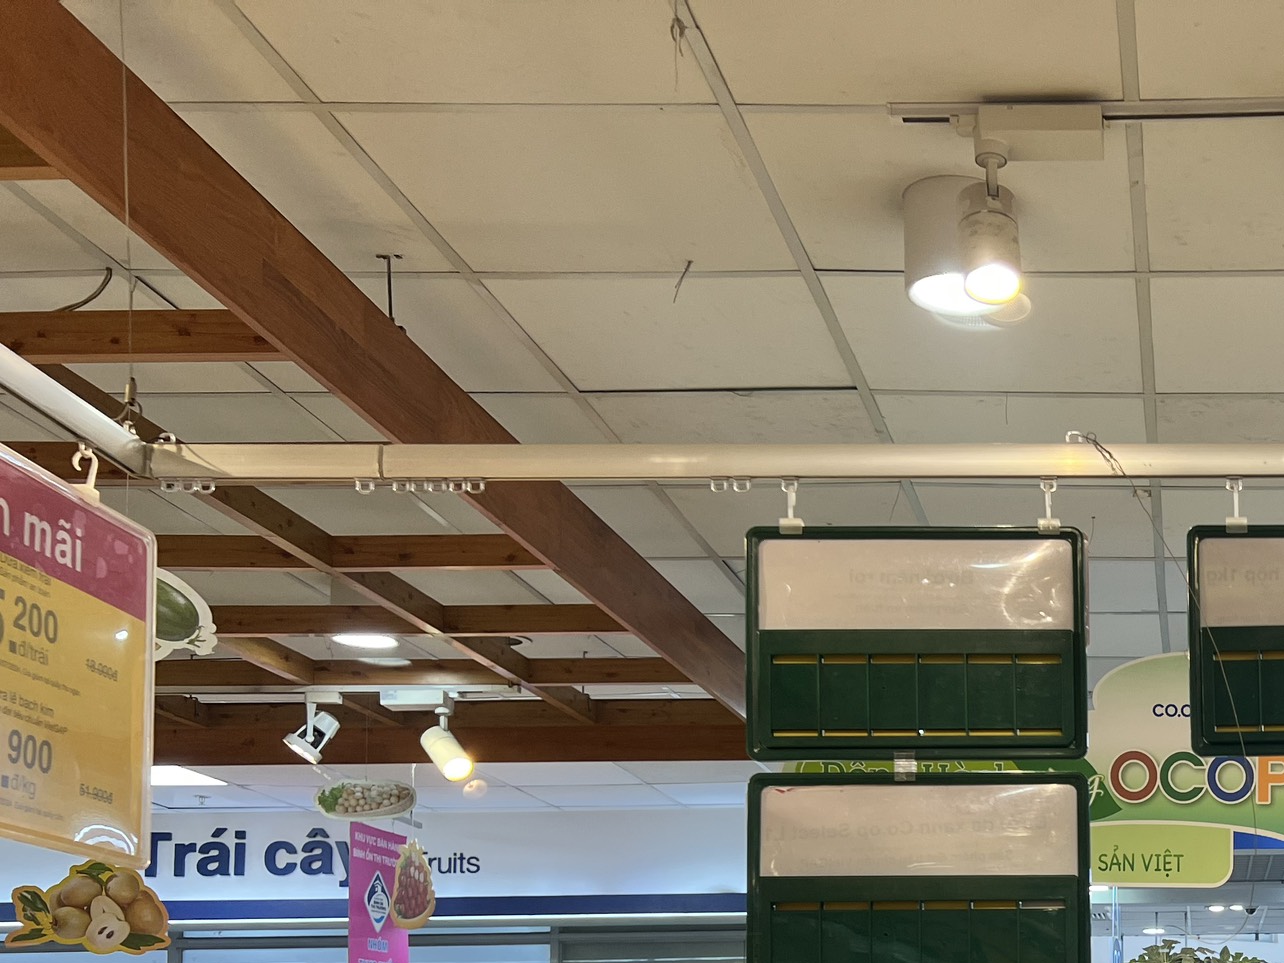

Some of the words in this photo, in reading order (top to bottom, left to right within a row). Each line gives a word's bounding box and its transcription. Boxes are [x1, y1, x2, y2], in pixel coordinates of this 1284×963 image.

[23, 511, 83, 573] mãi
[12, 594, 59, 644] 200
[8, 729, 53, 775] 900
[144, 828, 247, 878] Trái
[422, 848, 481, 875] ruits
[1097, 845, 1135, 872] SẢN
[1141, 848, 1185, 878] VIỆT
[367, 936, 388, 953] NHÓM
